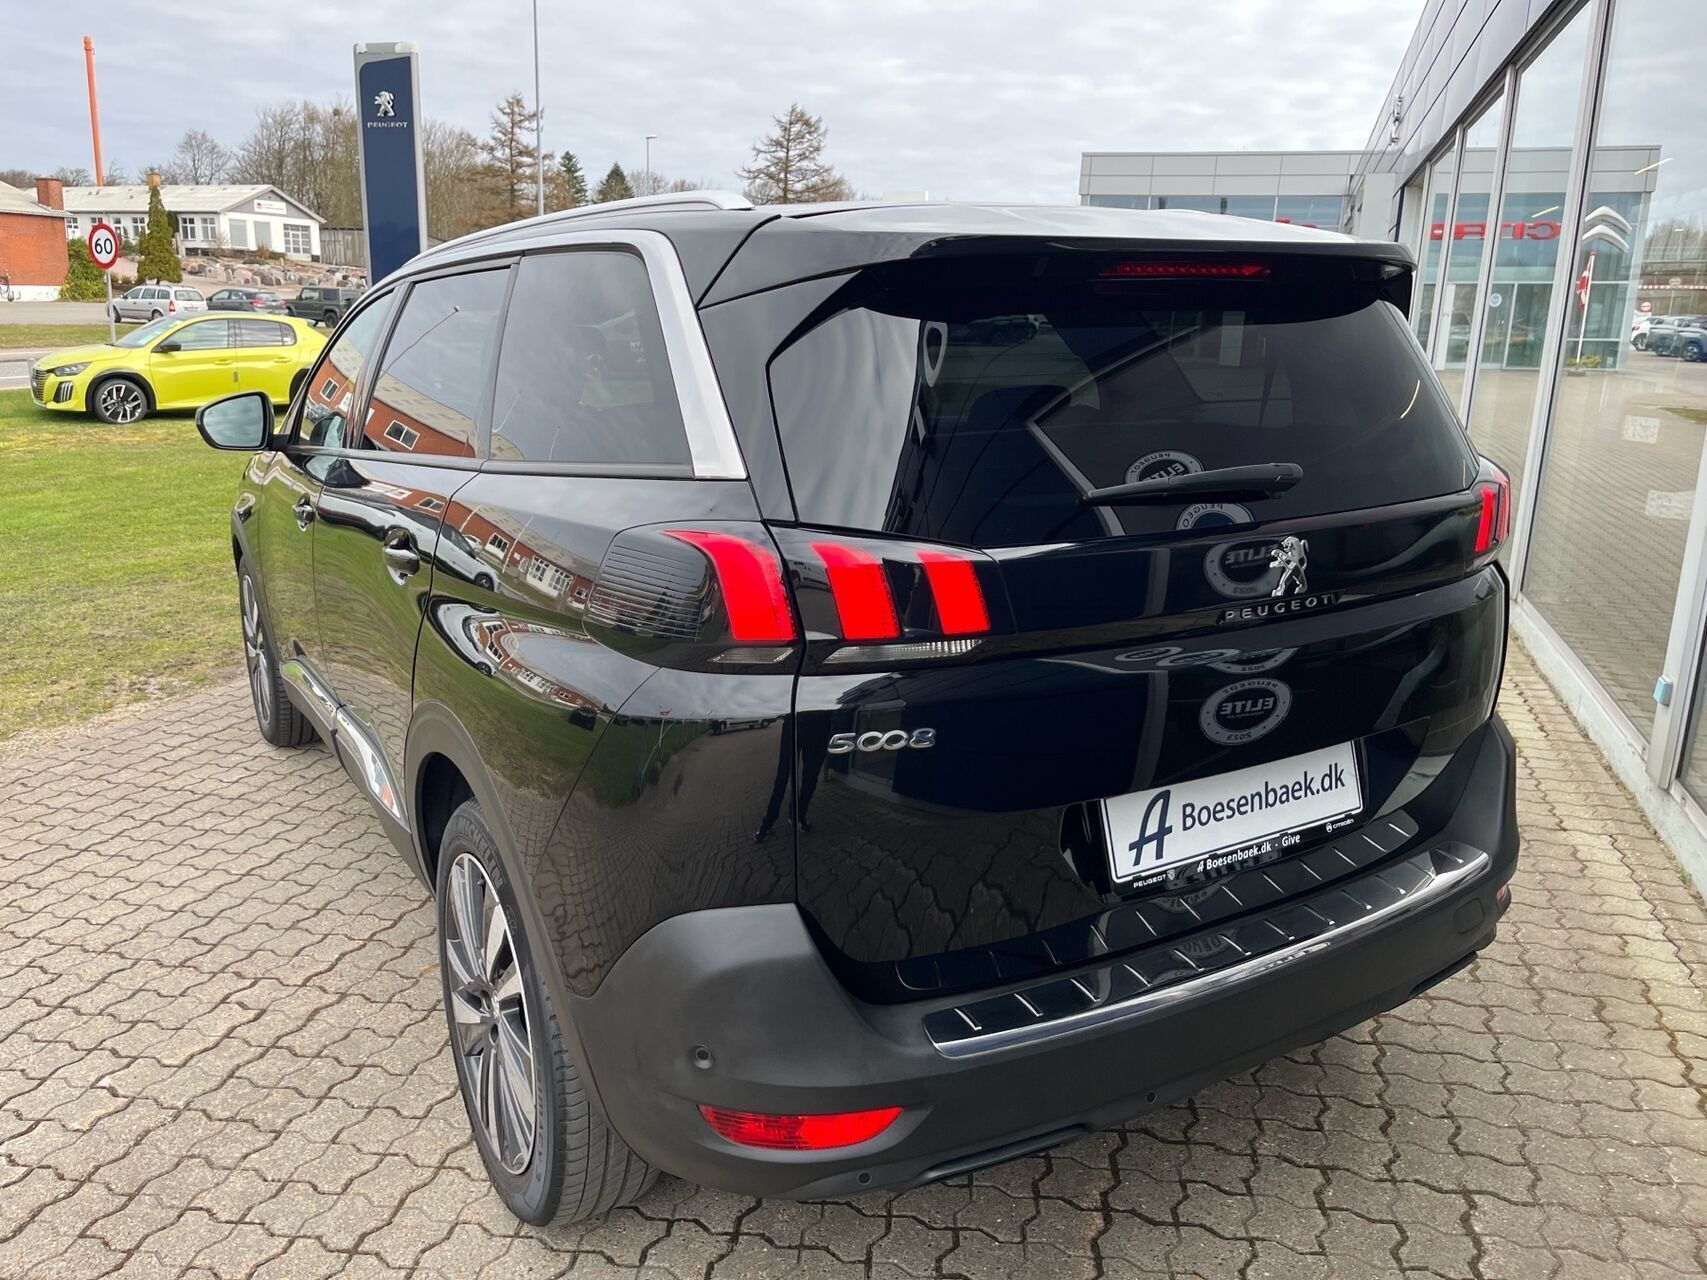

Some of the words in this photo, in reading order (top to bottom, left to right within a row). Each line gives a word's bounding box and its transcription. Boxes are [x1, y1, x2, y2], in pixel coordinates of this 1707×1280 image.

[95, 238, 113, 254] 60
[1224, 594, 1332, 619] PEUGEOT
[827, 727, 936, 754] 5008
[1181, 762, 1346, 832] Boesenbaek.dk
[1206, 841, 1272, 870] Boesenbaek.dk
[1281, 834, 1301, 847] Give
[1133, 874, 1167, 888] PEUGEOT
